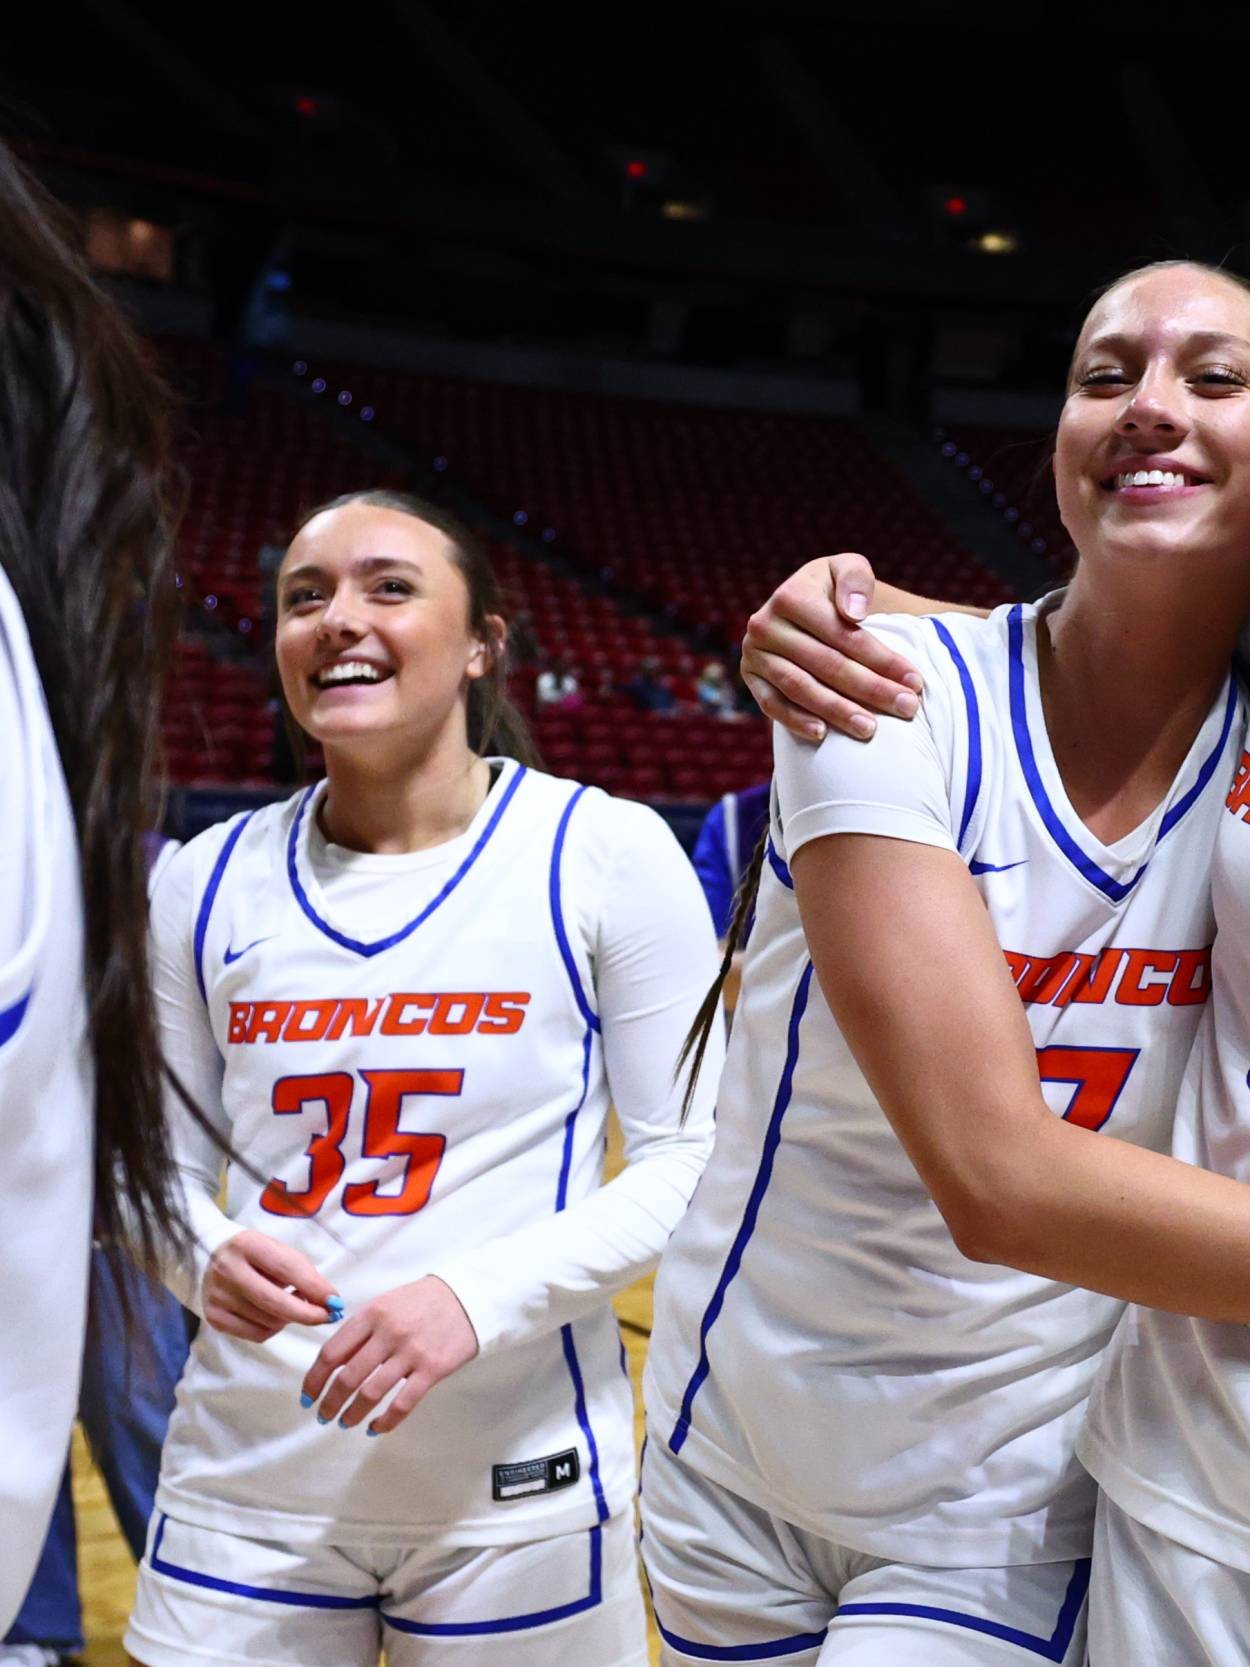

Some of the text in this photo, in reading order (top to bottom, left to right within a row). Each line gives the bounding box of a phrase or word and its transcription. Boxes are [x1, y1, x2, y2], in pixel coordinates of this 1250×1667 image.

[227, 992, 531, 1044] BRONCOS
[259, 1068, 465, 1218] 35
[555, 1462, 571, 1480] M
